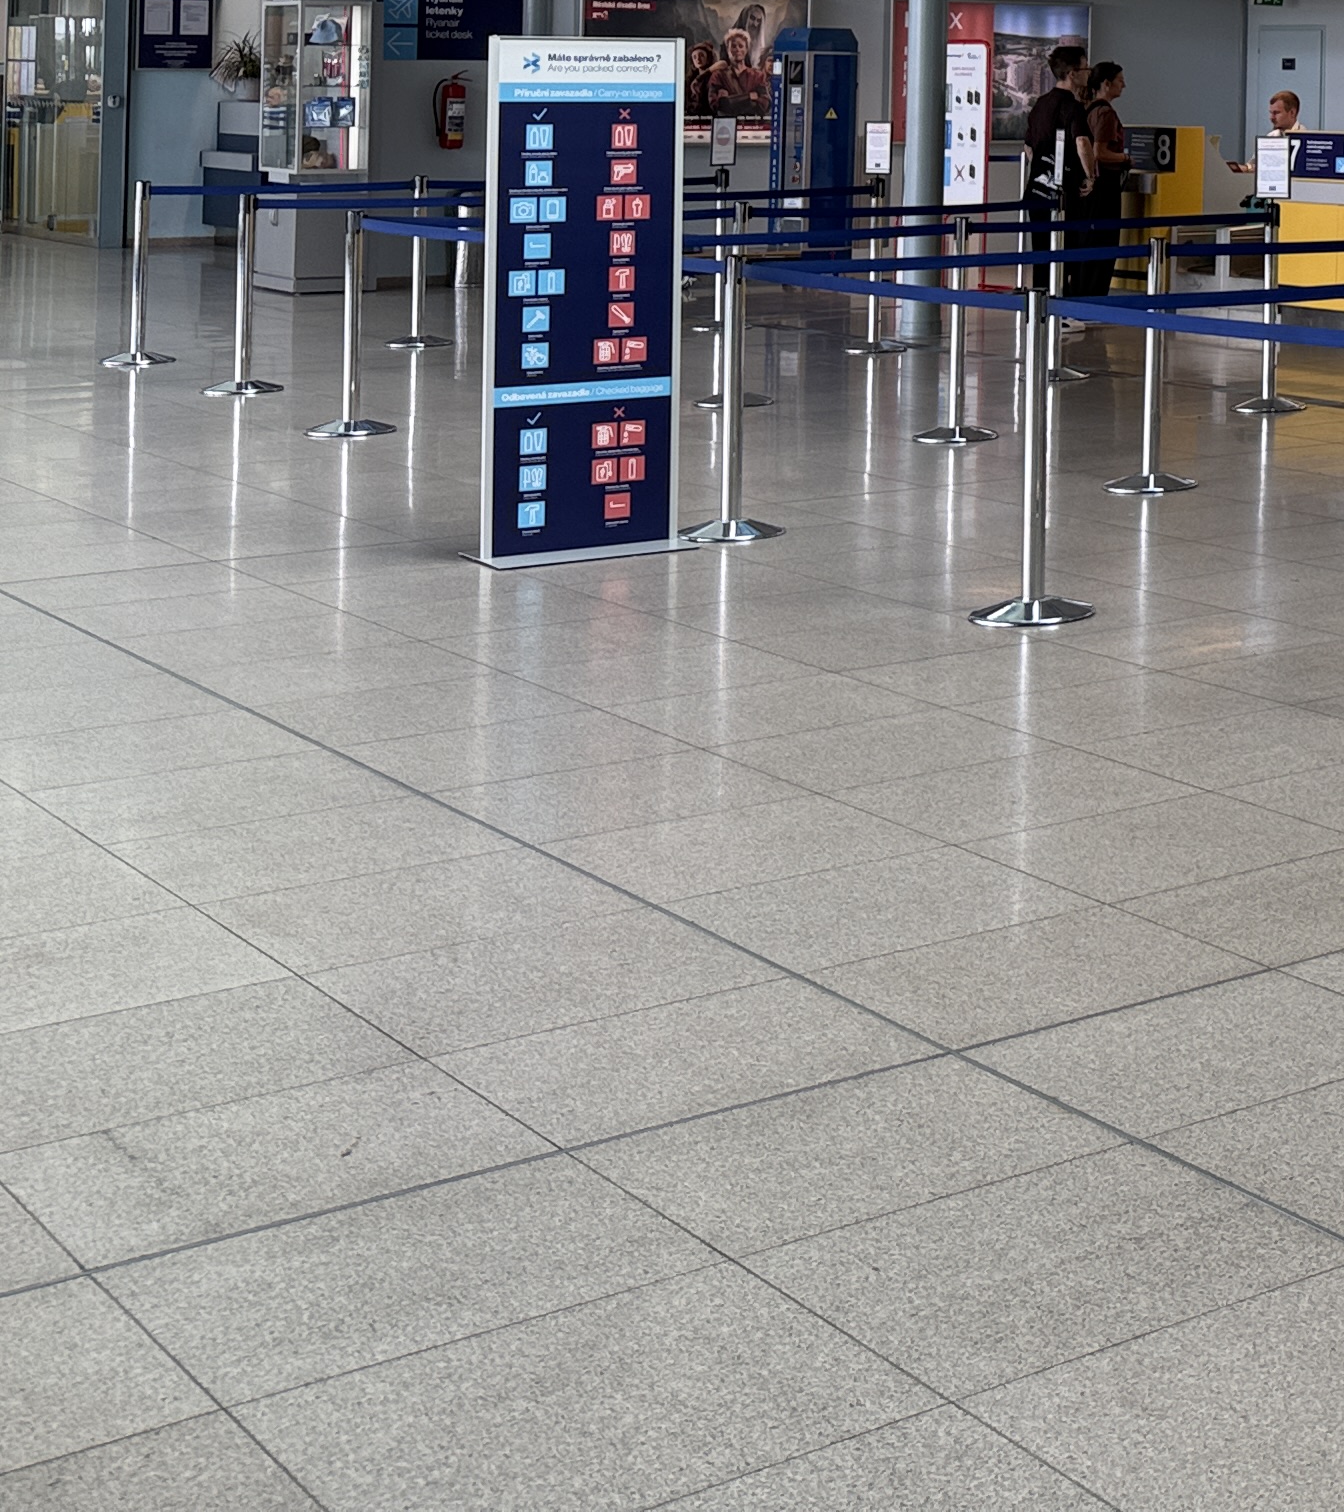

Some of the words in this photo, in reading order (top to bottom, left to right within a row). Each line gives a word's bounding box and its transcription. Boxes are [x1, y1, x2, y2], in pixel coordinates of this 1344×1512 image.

[426, 6, 464, 17] letenky
[426, 18, 460, 28] Ryanair
[426, 29, 450, 39] ticket
[451, 29, 473, 39] desk
[548, 53, 572, 63] Máte
[573, 54, 611, 64] správně
[613, 53, 654, 62] zabaleno
[547, 64, 563, 73] Are
[564, 65, 580, 74] you
[583, 63, 615, 73] packed
[617, 63, 658, 74] correctly?
[1157, 134, 1170, 165] 8
[1290, 139, 1301, 172] 7
